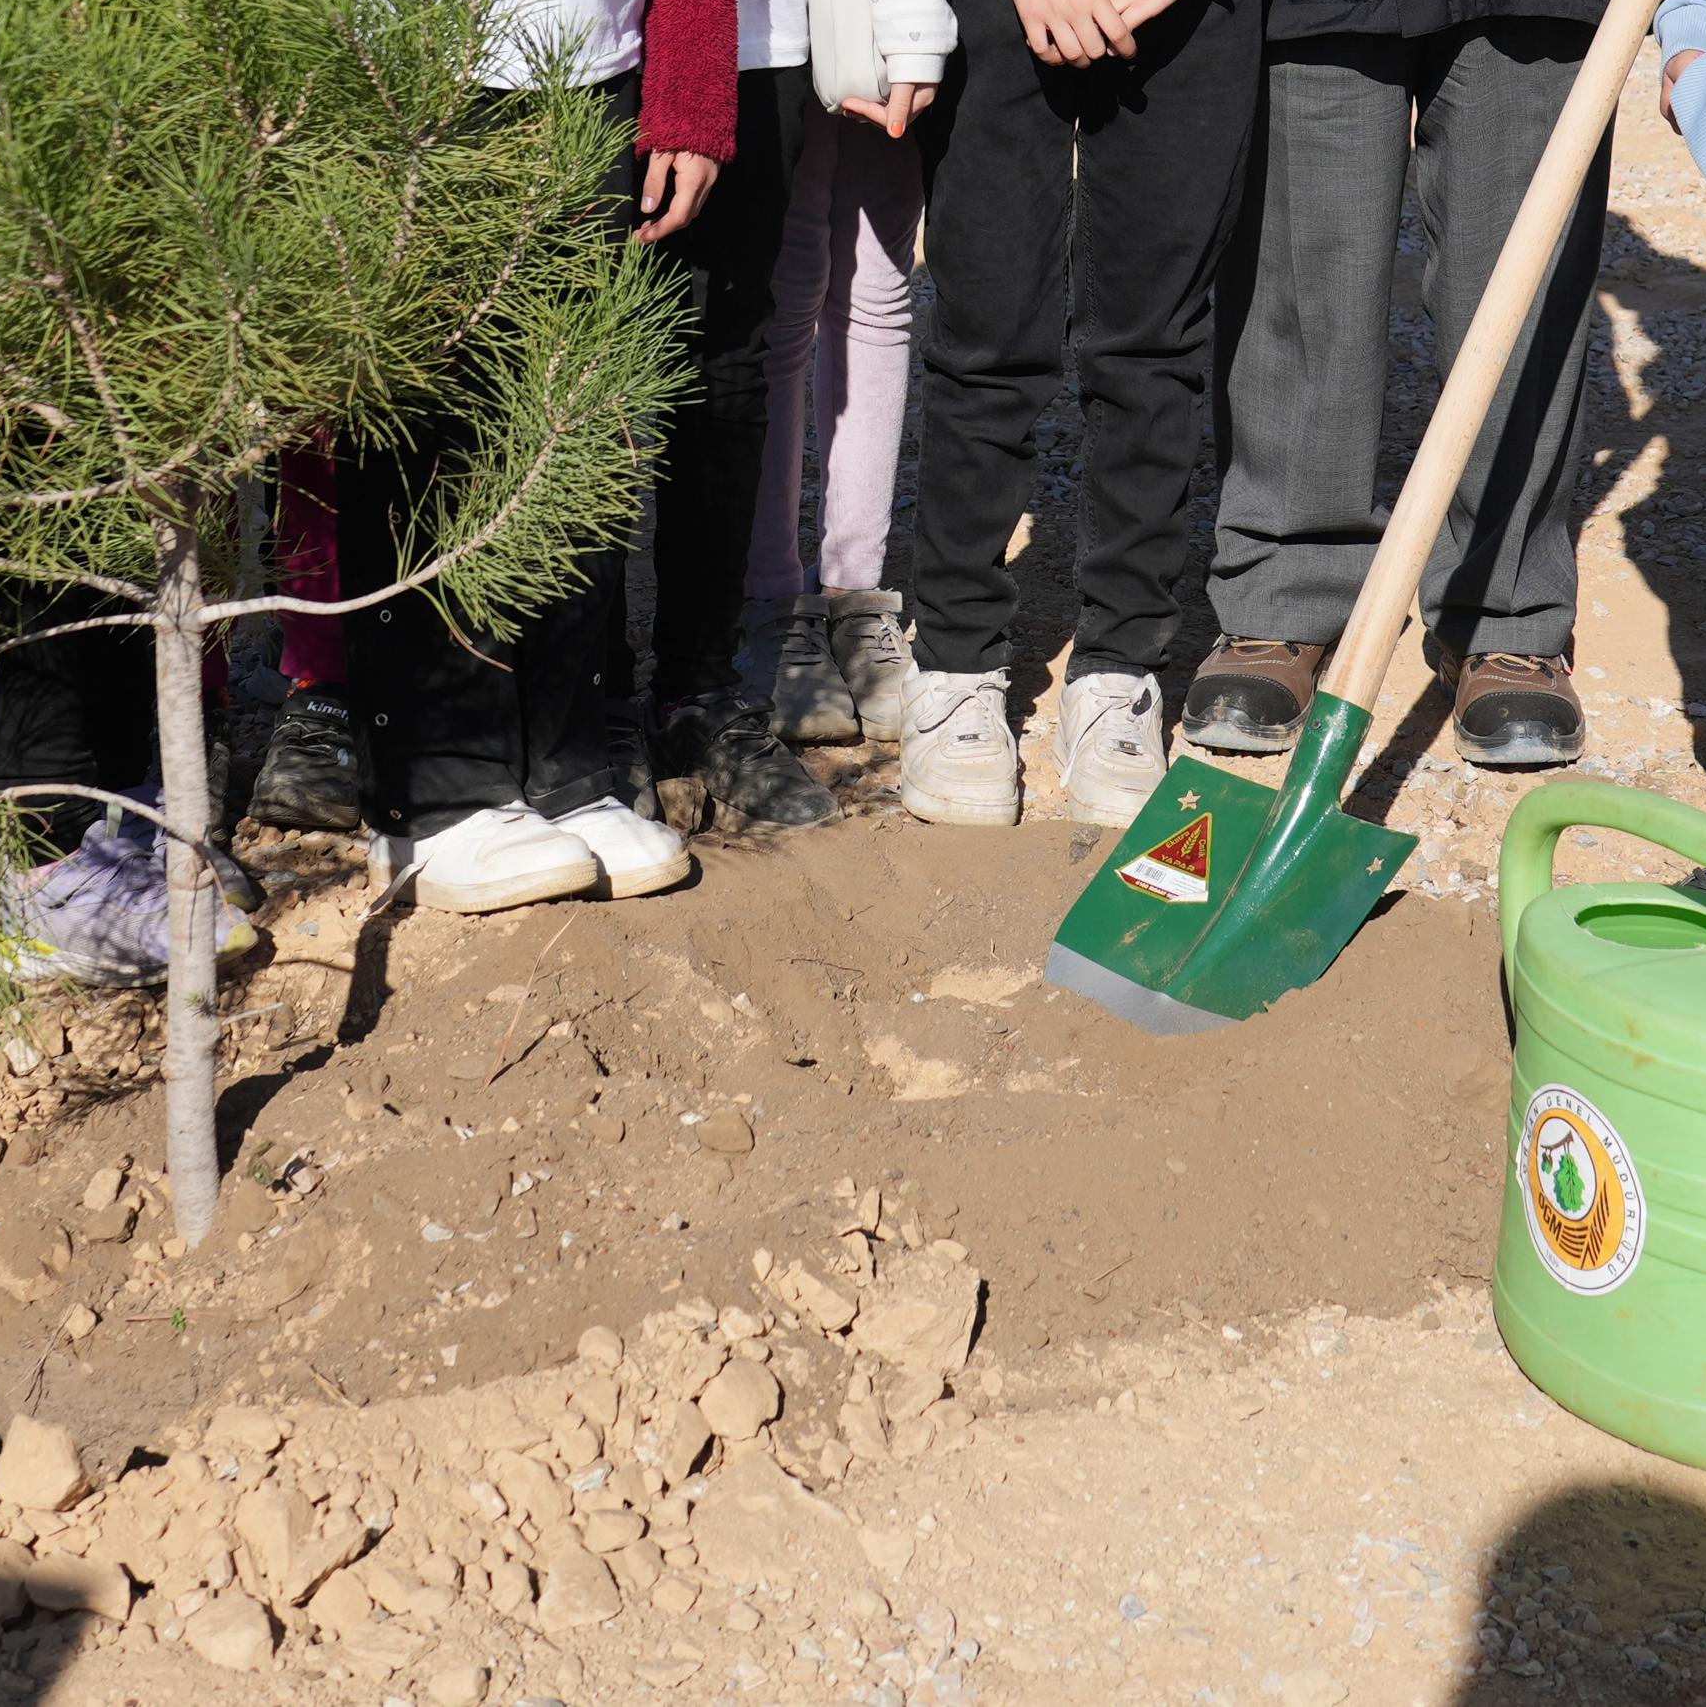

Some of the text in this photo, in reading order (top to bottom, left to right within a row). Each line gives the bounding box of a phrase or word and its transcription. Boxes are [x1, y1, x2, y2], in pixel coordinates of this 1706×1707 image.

[1160, 854, 1196, 873] YAPAR
[1545, 1095, 1593, 1125] GENEL
[1538, 1191, 1563, 1242] OGM
